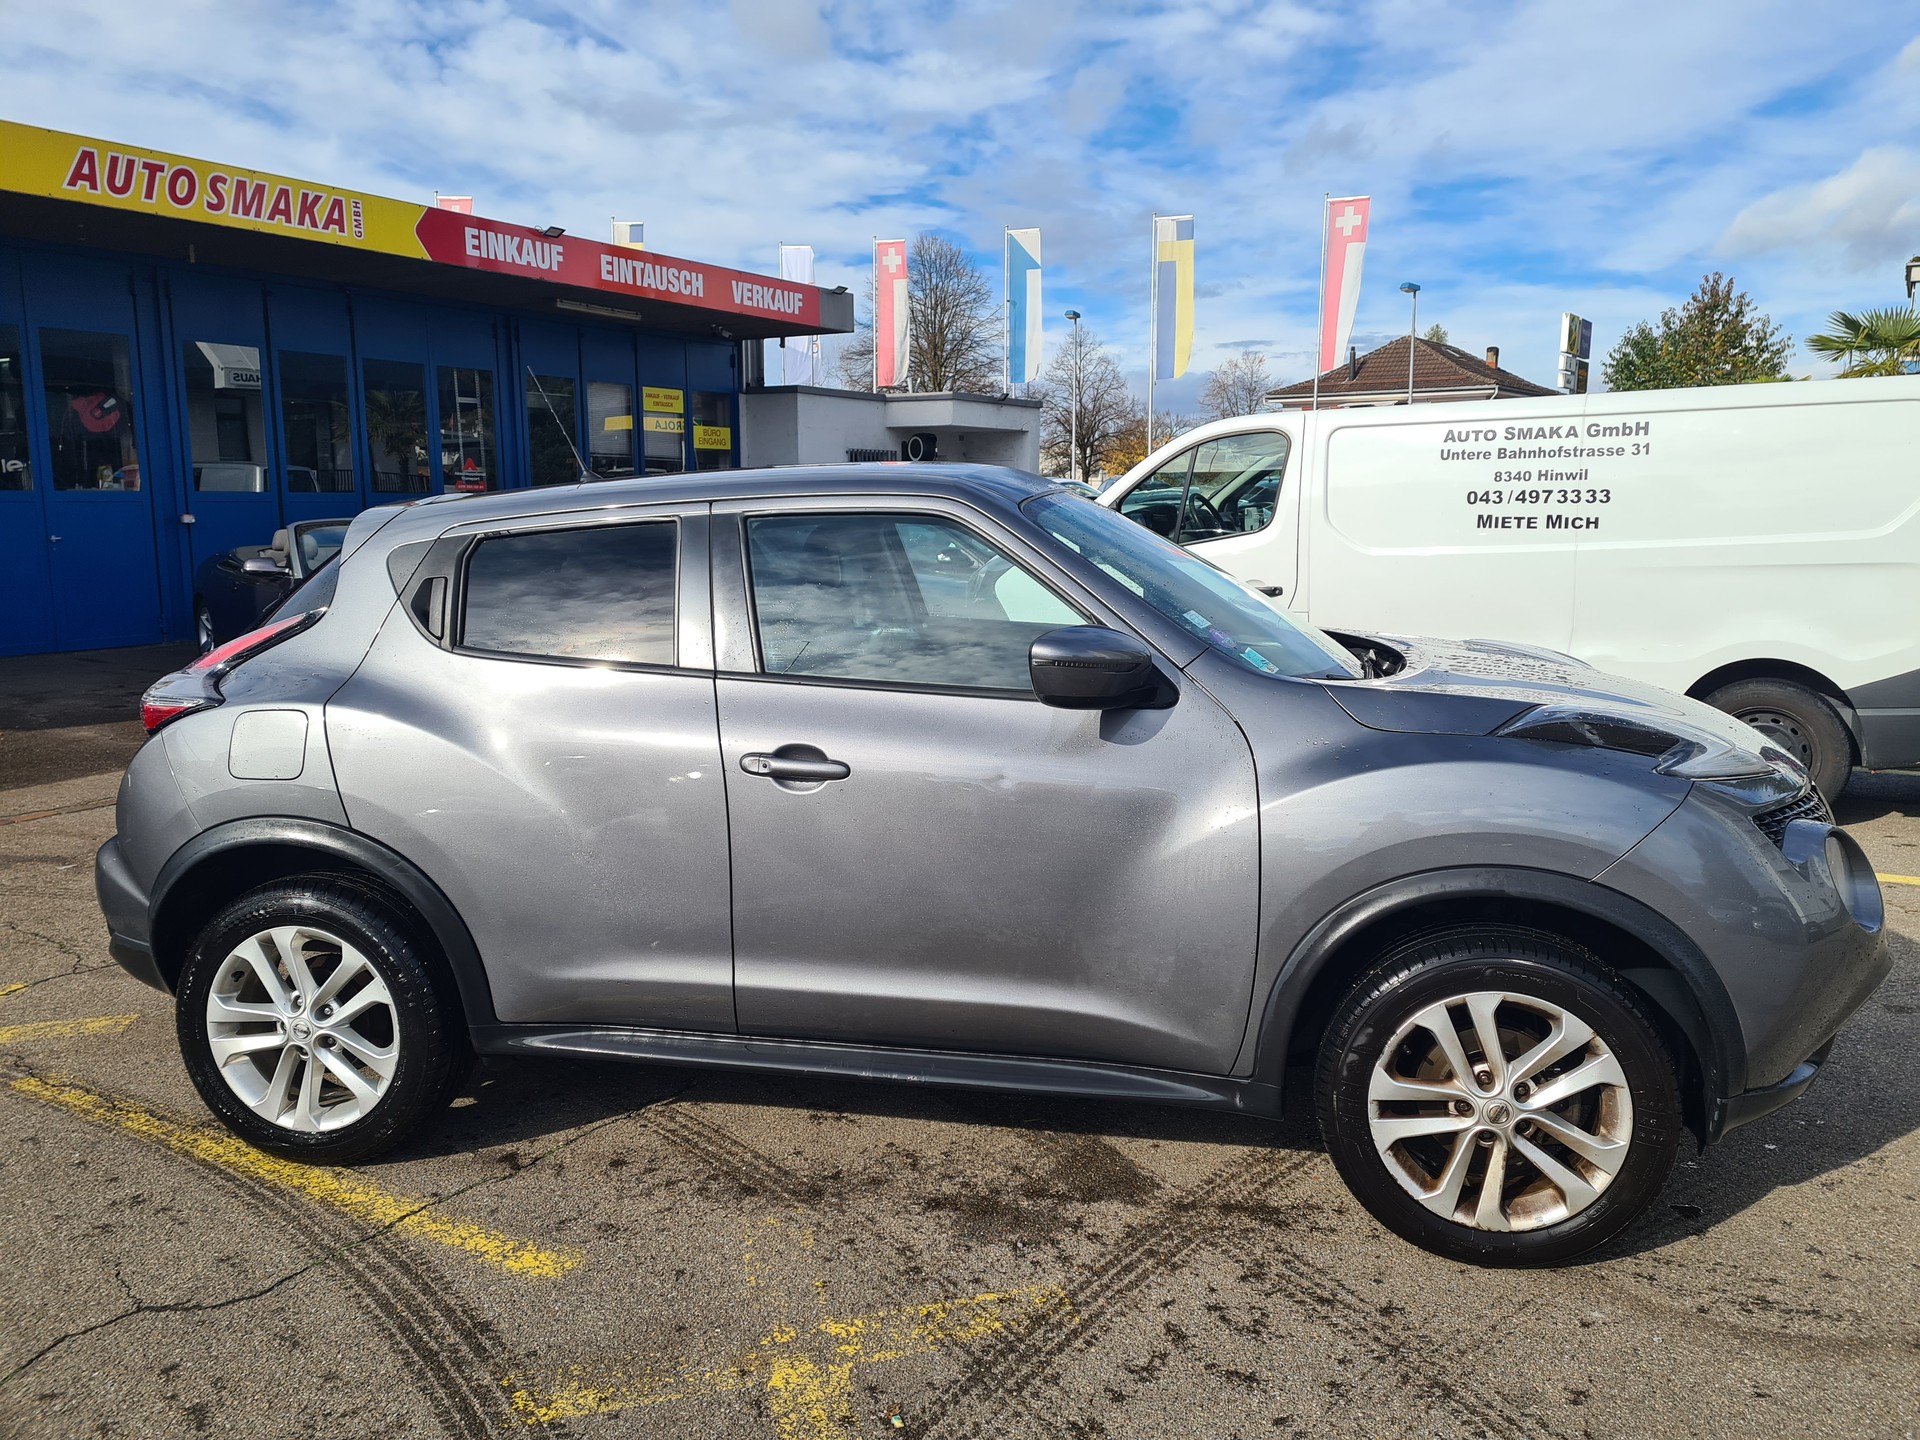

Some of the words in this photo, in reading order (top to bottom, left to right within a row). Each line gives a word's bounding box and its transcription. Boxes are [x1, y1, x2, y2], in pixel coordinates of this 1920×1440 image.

[63, 147, 199, 208] AUTO
[204, 173, 348, 236] SMAKA
[352, 200, 364, 239] GMBH
[464, 226, 564, 271] EINKAUF
[600, 254, 703, 298] EINTAUSCH
[731, 280, 803, 315] VERKAUF
[698, 437, 726, 446] EINGANG
[703, 428, 721, 437] BÜRO
[1443, 427, 1497, 443] AUTO
[1504, 425, 1579, 441] SMAKA
[1586, 421, 1650, 438] GmbH
[1440, 448, 1492, 461] Untere
[1497, 446, 1625, 460] Bahnhofstrasse
[1631, 443, 1650, 456] 31
[1494, 471, 1532, 482] 8340
[1537, 469, 1588, 481] Hinwil
